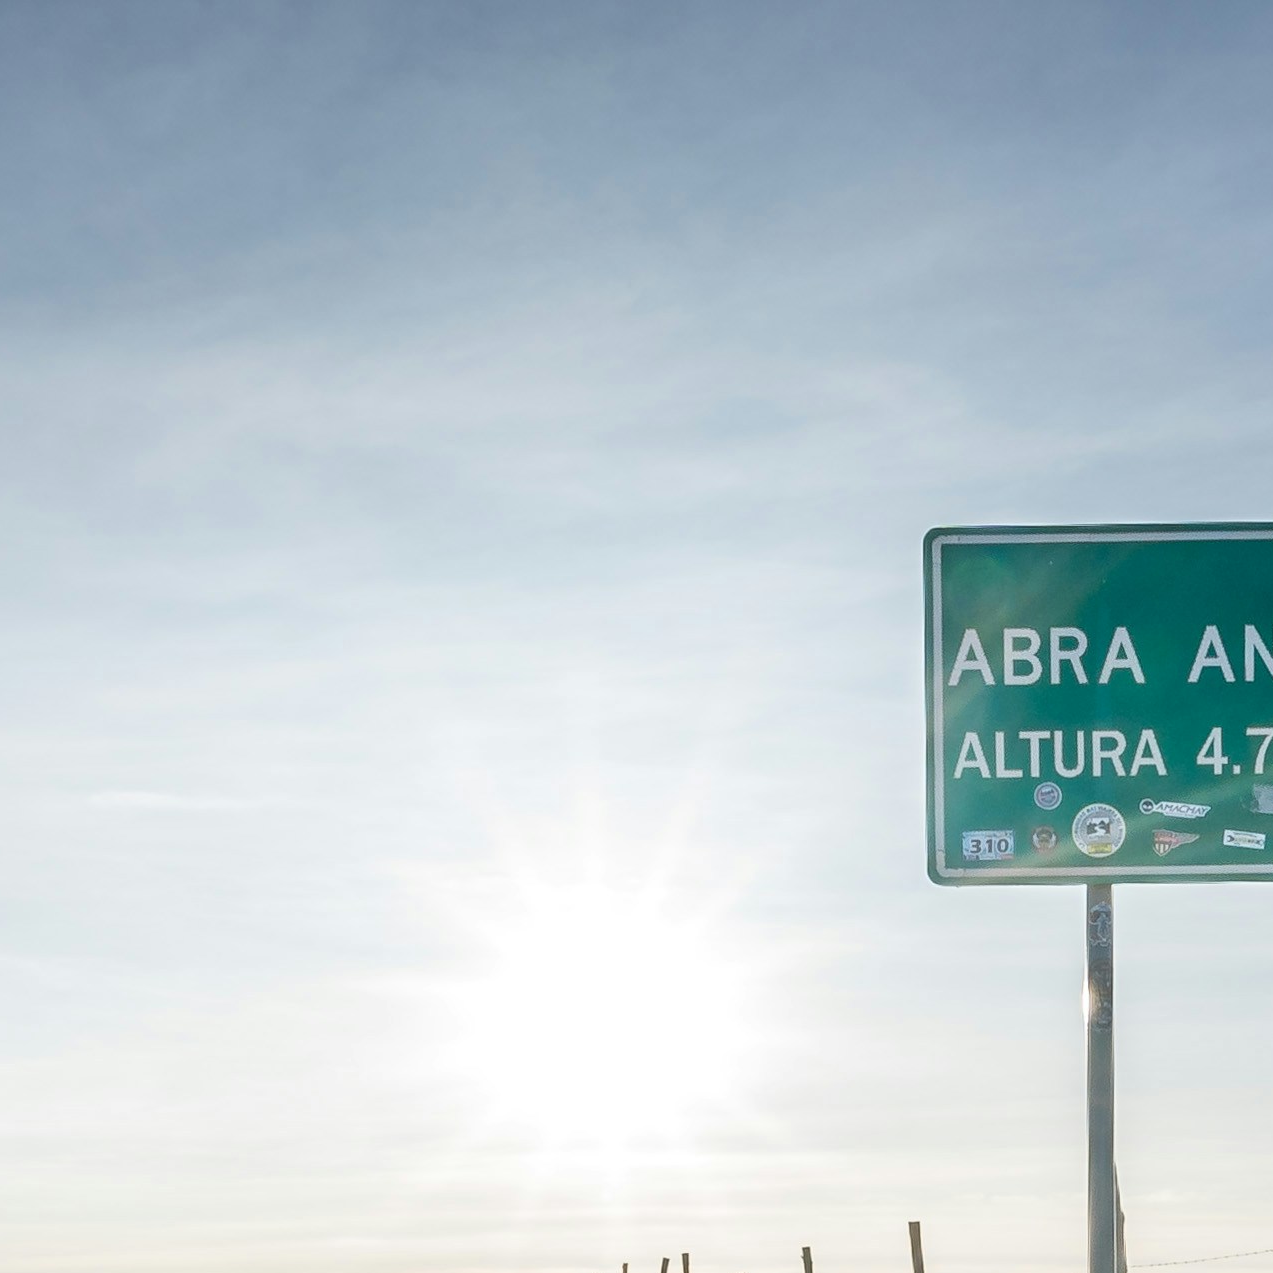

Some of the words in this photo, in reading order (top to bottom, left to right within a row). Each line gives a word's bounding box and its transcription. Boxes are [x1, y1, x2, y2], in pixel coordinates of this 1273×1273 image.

[948, 626, 1145, 686] ABRA
[953, 729, 1167, 779] ALTURA
[970, 838, 1009, 853] 310
